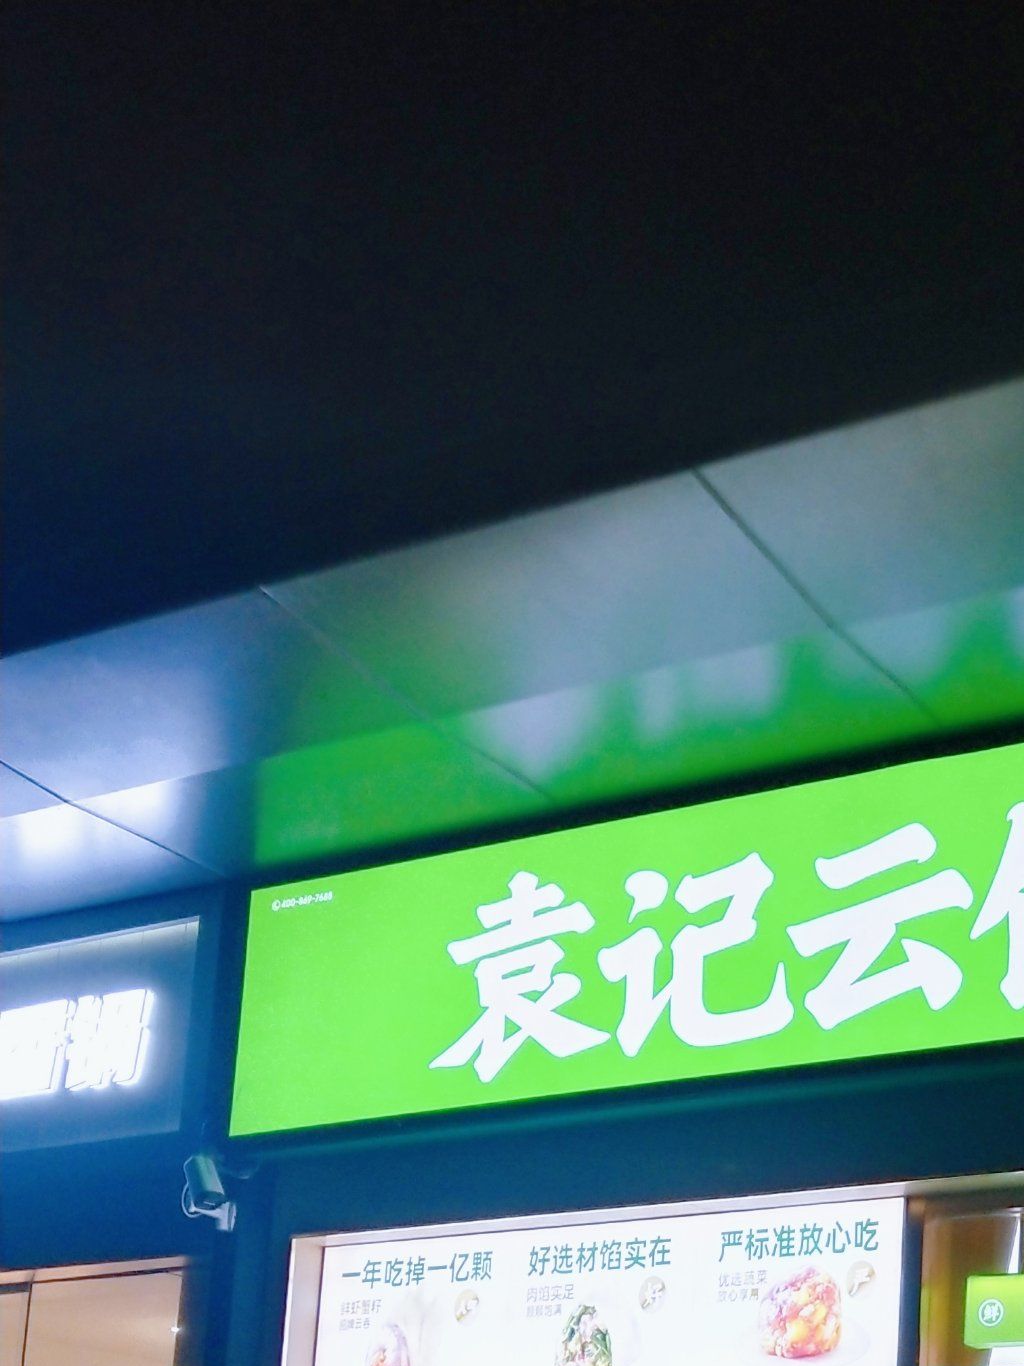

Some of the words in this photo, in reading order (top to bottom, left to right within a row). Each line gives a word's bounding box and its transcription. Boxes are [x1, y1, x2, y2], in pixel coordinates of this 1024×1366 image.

[528, 1236, 672, 1277] 好选材馅实在
[718, 1218, 879, 1263] 严标准放心吃
[341, 1250, 493, 1289] 一年吃掉一亿颗
